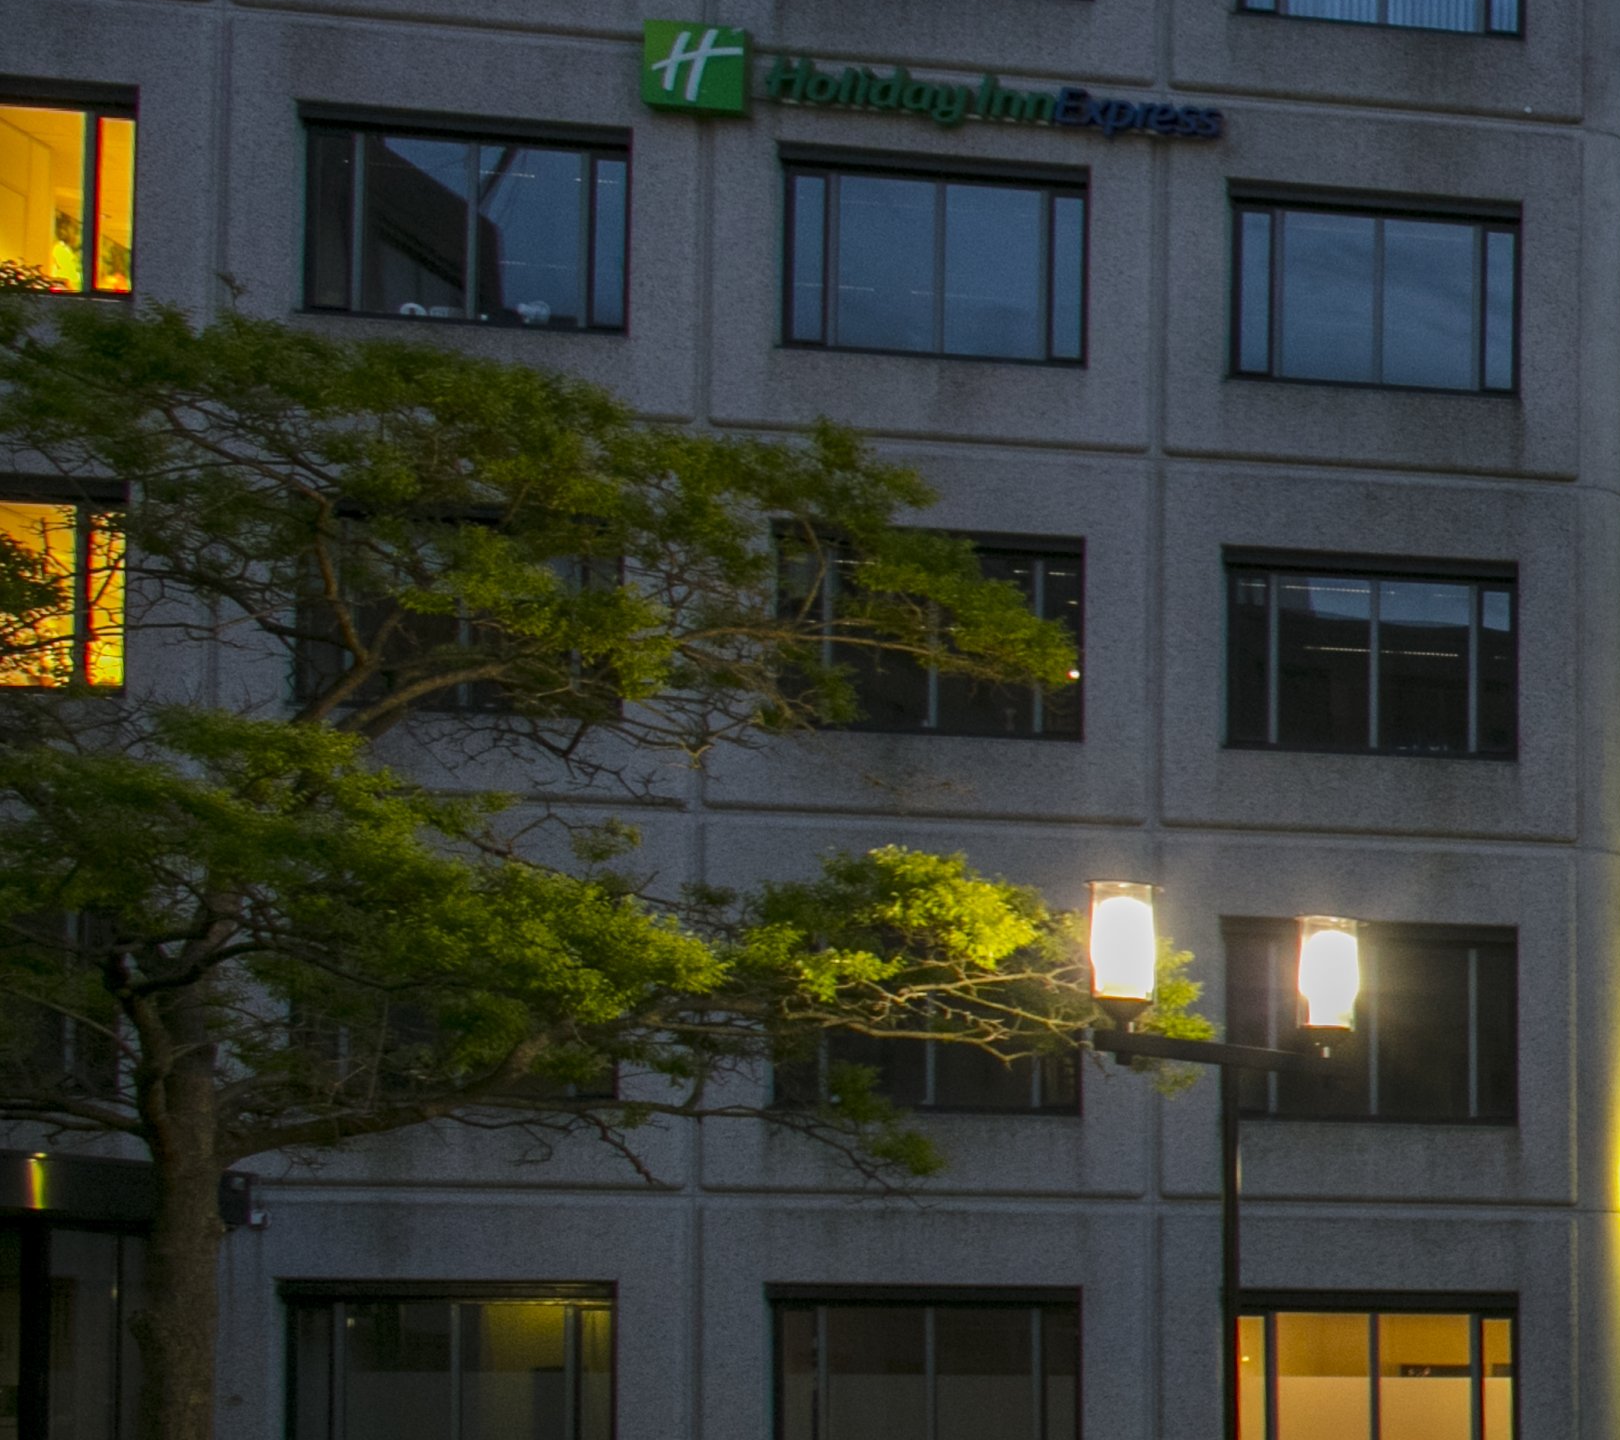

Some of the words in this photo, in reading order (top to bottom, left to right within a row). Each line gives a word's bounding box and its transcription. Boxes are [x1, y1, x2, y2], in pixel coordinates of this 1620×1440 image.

[767, 54, 967, 128] Holiday
[975, 71, 1056, 123] Inn
[1053, 86, 1226, 140] Express
